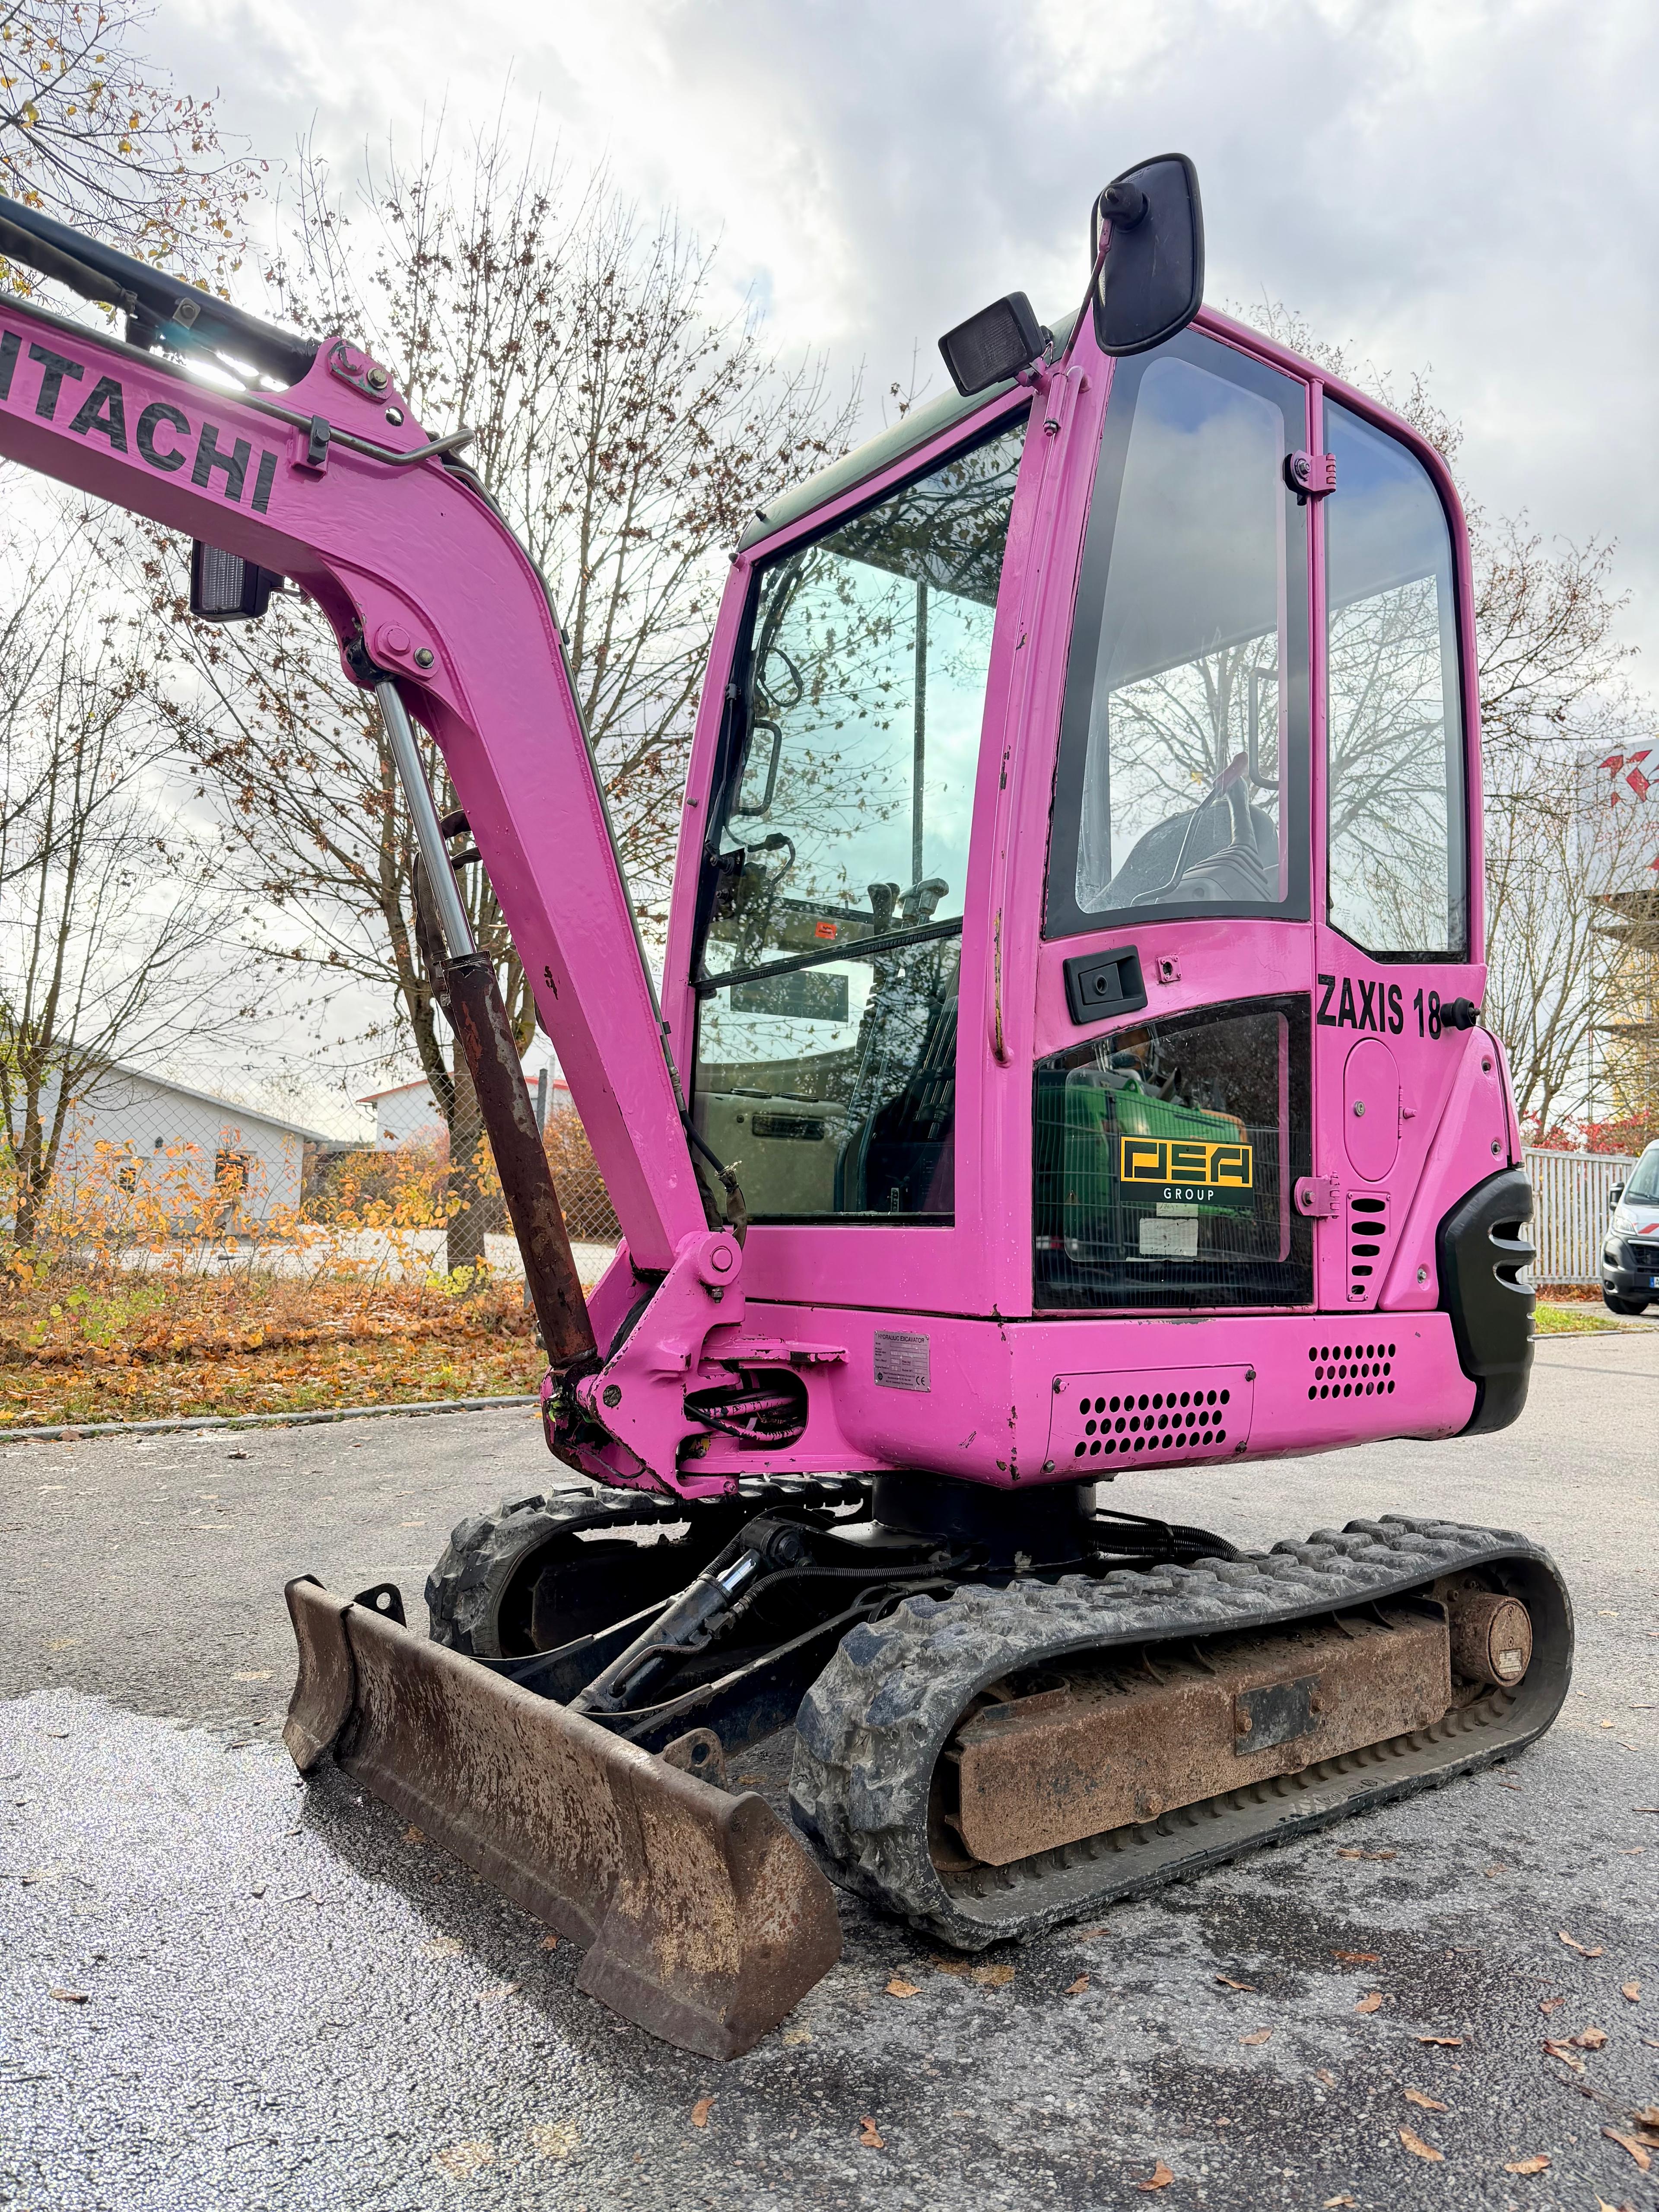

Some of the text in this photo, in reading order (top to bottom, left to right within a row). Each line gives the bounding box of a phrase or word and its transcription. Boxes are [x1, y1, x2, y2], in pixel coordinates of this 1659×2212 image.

[0, 330, 278, 515] ITACHI
[1317, 973, 1442, 1040] ZAXIS 18
[1163, 1188, 1214, 1201] GROUP
